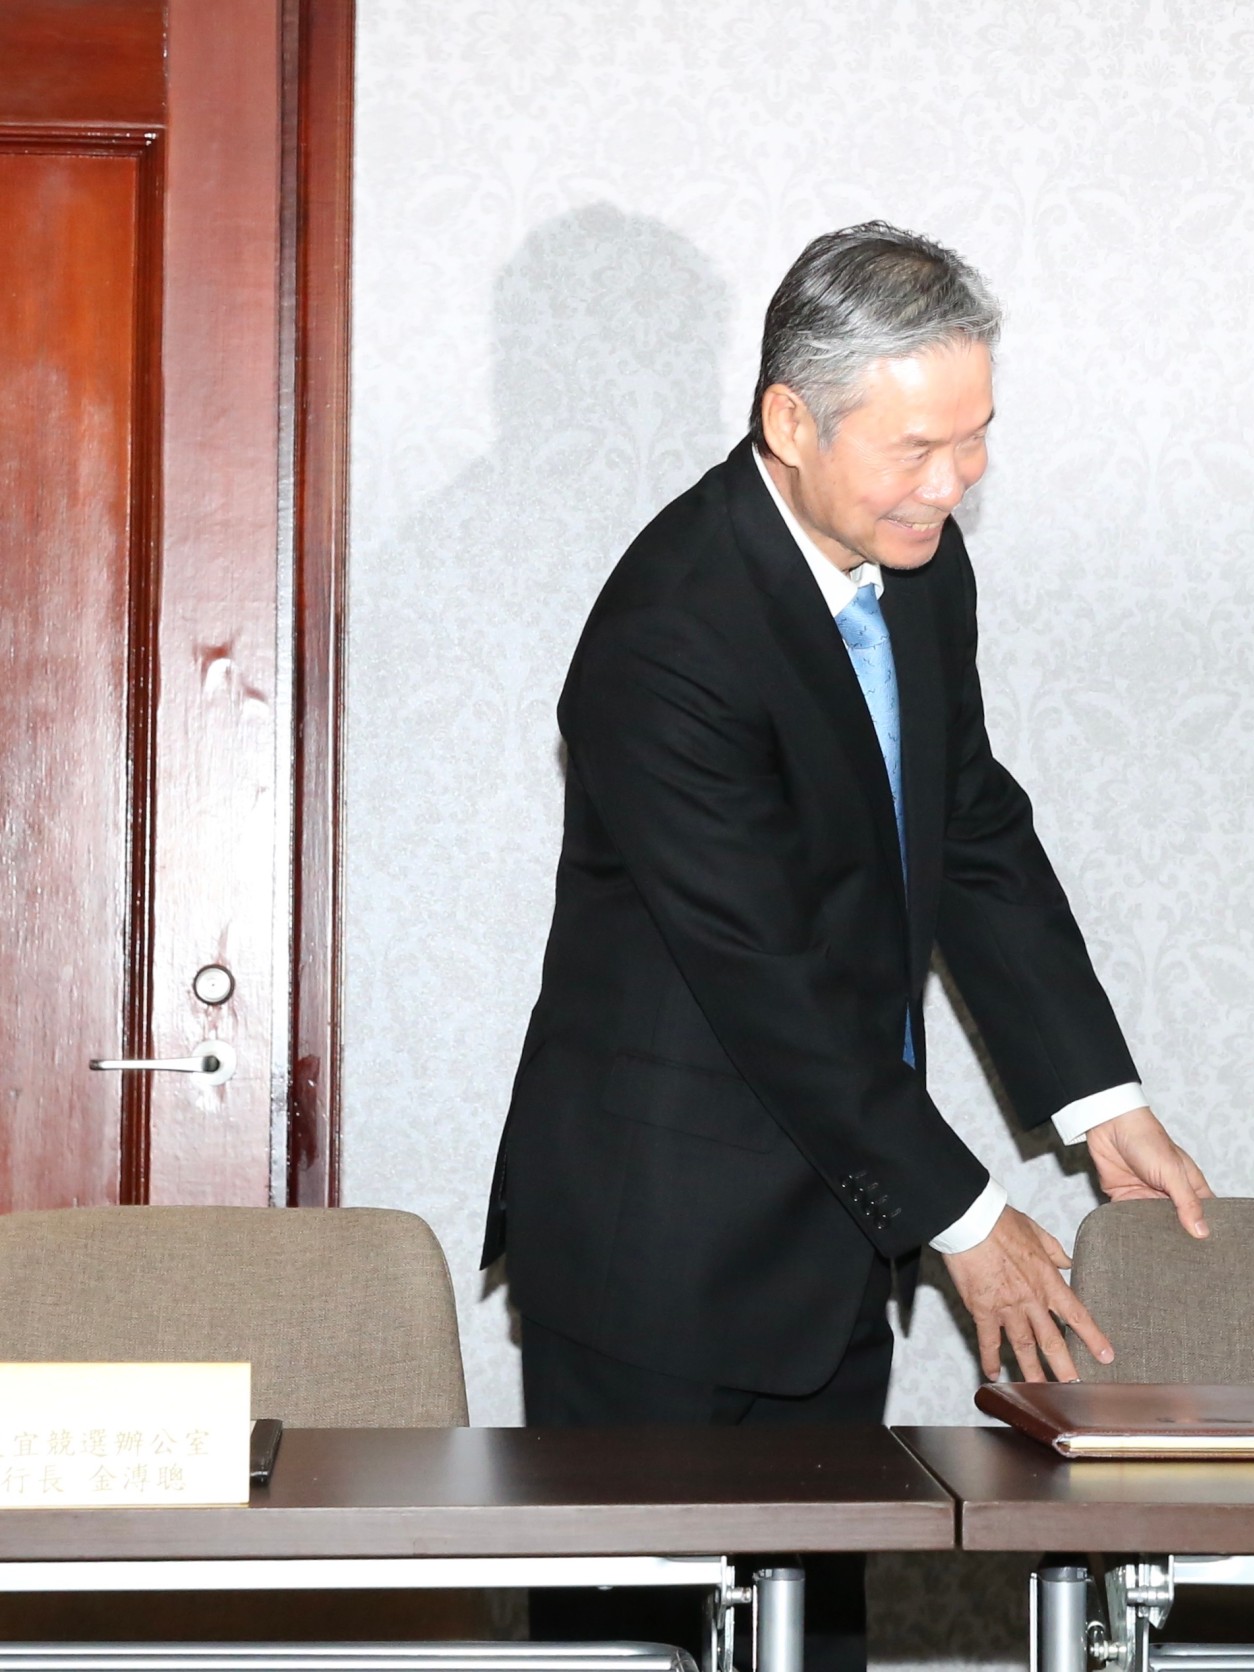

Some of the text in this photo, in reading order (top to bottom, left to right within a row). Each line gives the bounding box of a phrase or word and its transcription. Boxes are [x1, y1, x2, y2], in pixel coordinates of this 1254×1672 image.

[0, 1428, 209, 1457] 宜競選辦公室
[89, 1463, 188, 1493] 金溥聰
